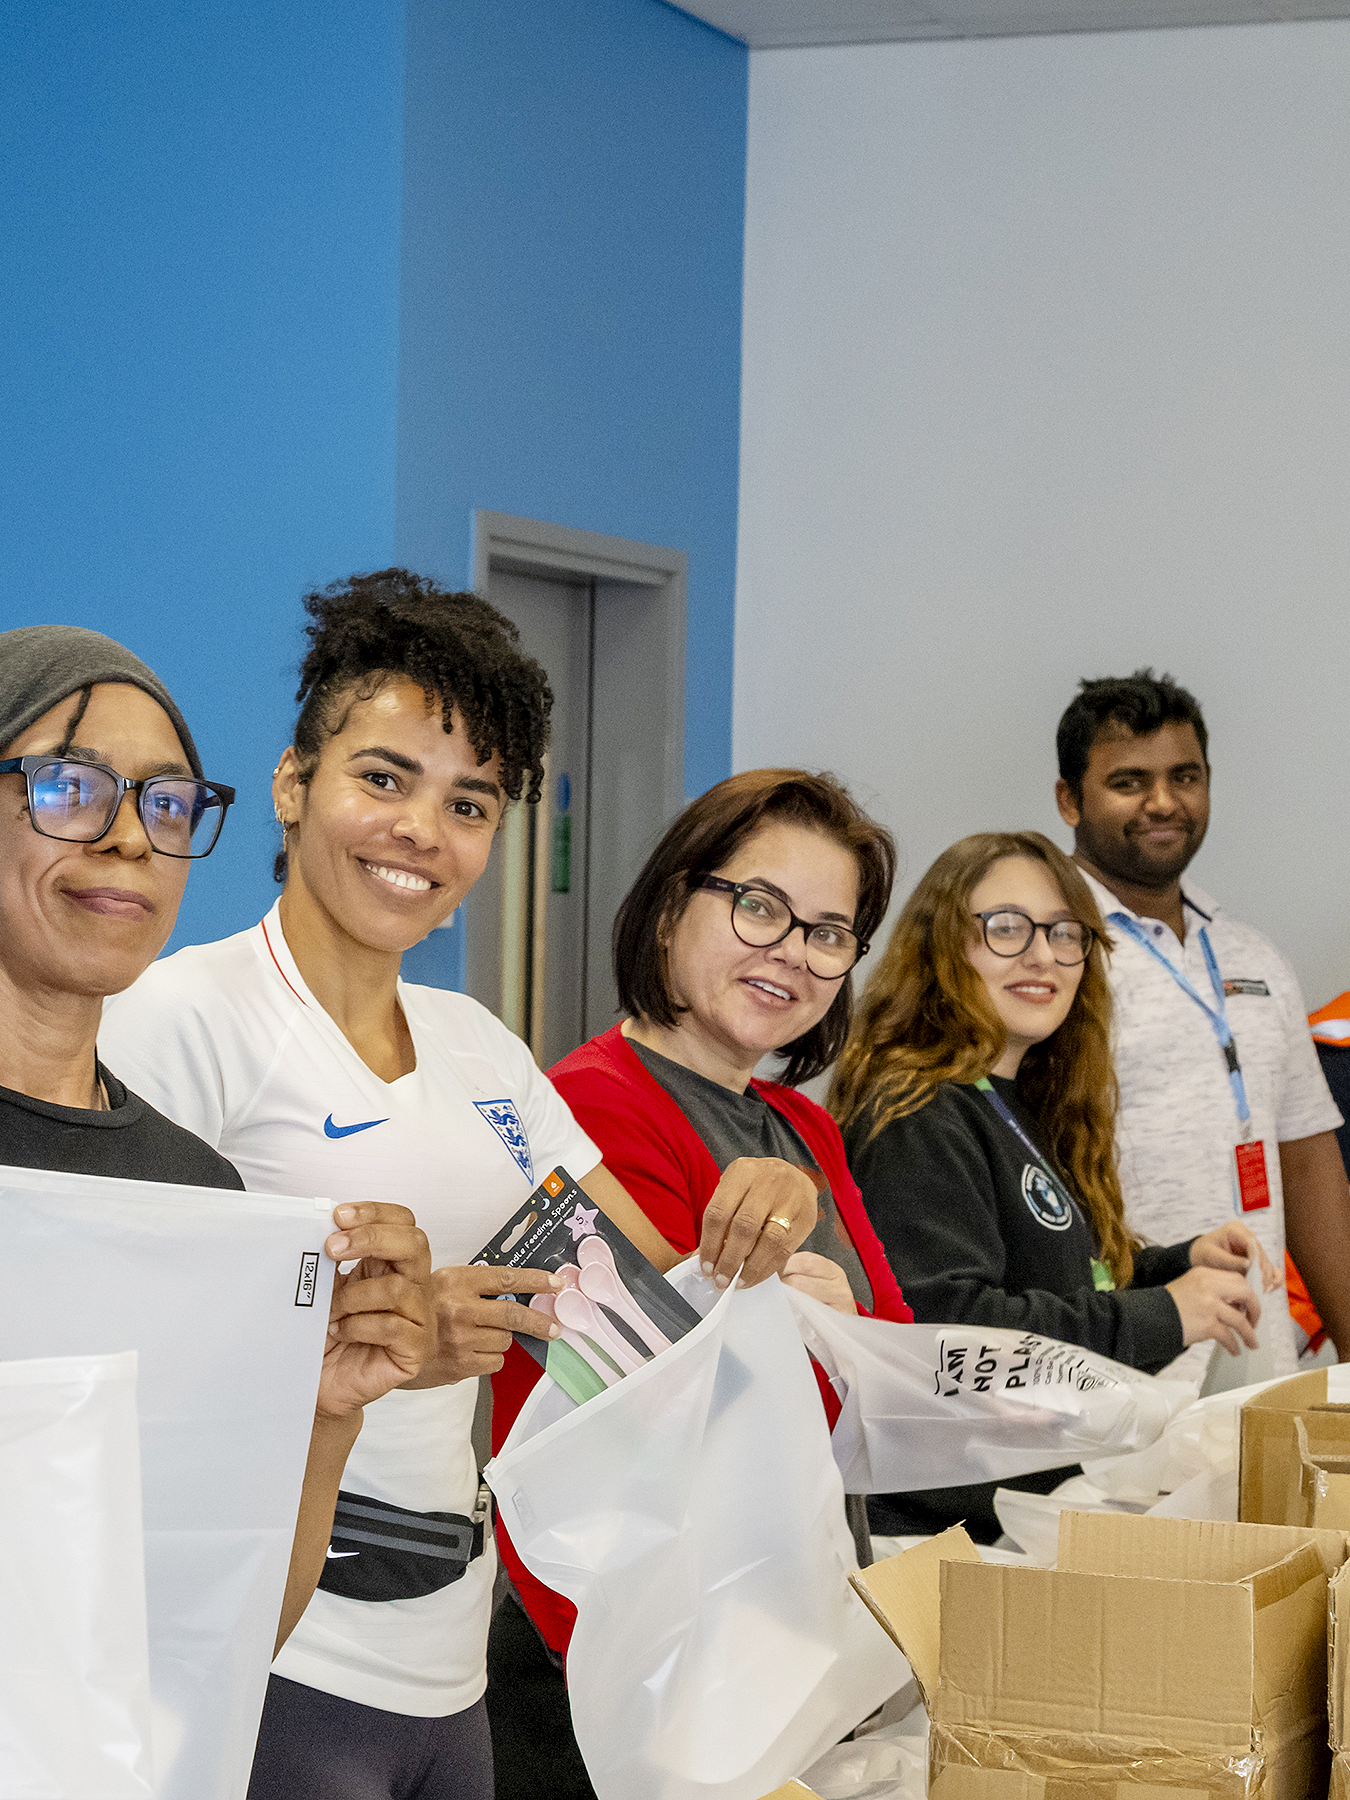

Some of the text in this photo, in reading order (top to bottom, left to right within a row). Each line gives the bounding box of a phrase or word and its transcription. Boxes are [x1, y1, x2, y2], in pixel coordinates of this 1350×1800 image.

[550, 1181, 557, 1189] 6
[524, 1218, 553, 1249] Feeding
[551, 1188, 578, 1218] Spoons
[575, 1215, 585, 1226] 5
[970, 1345, 1001, 1392] NOT
